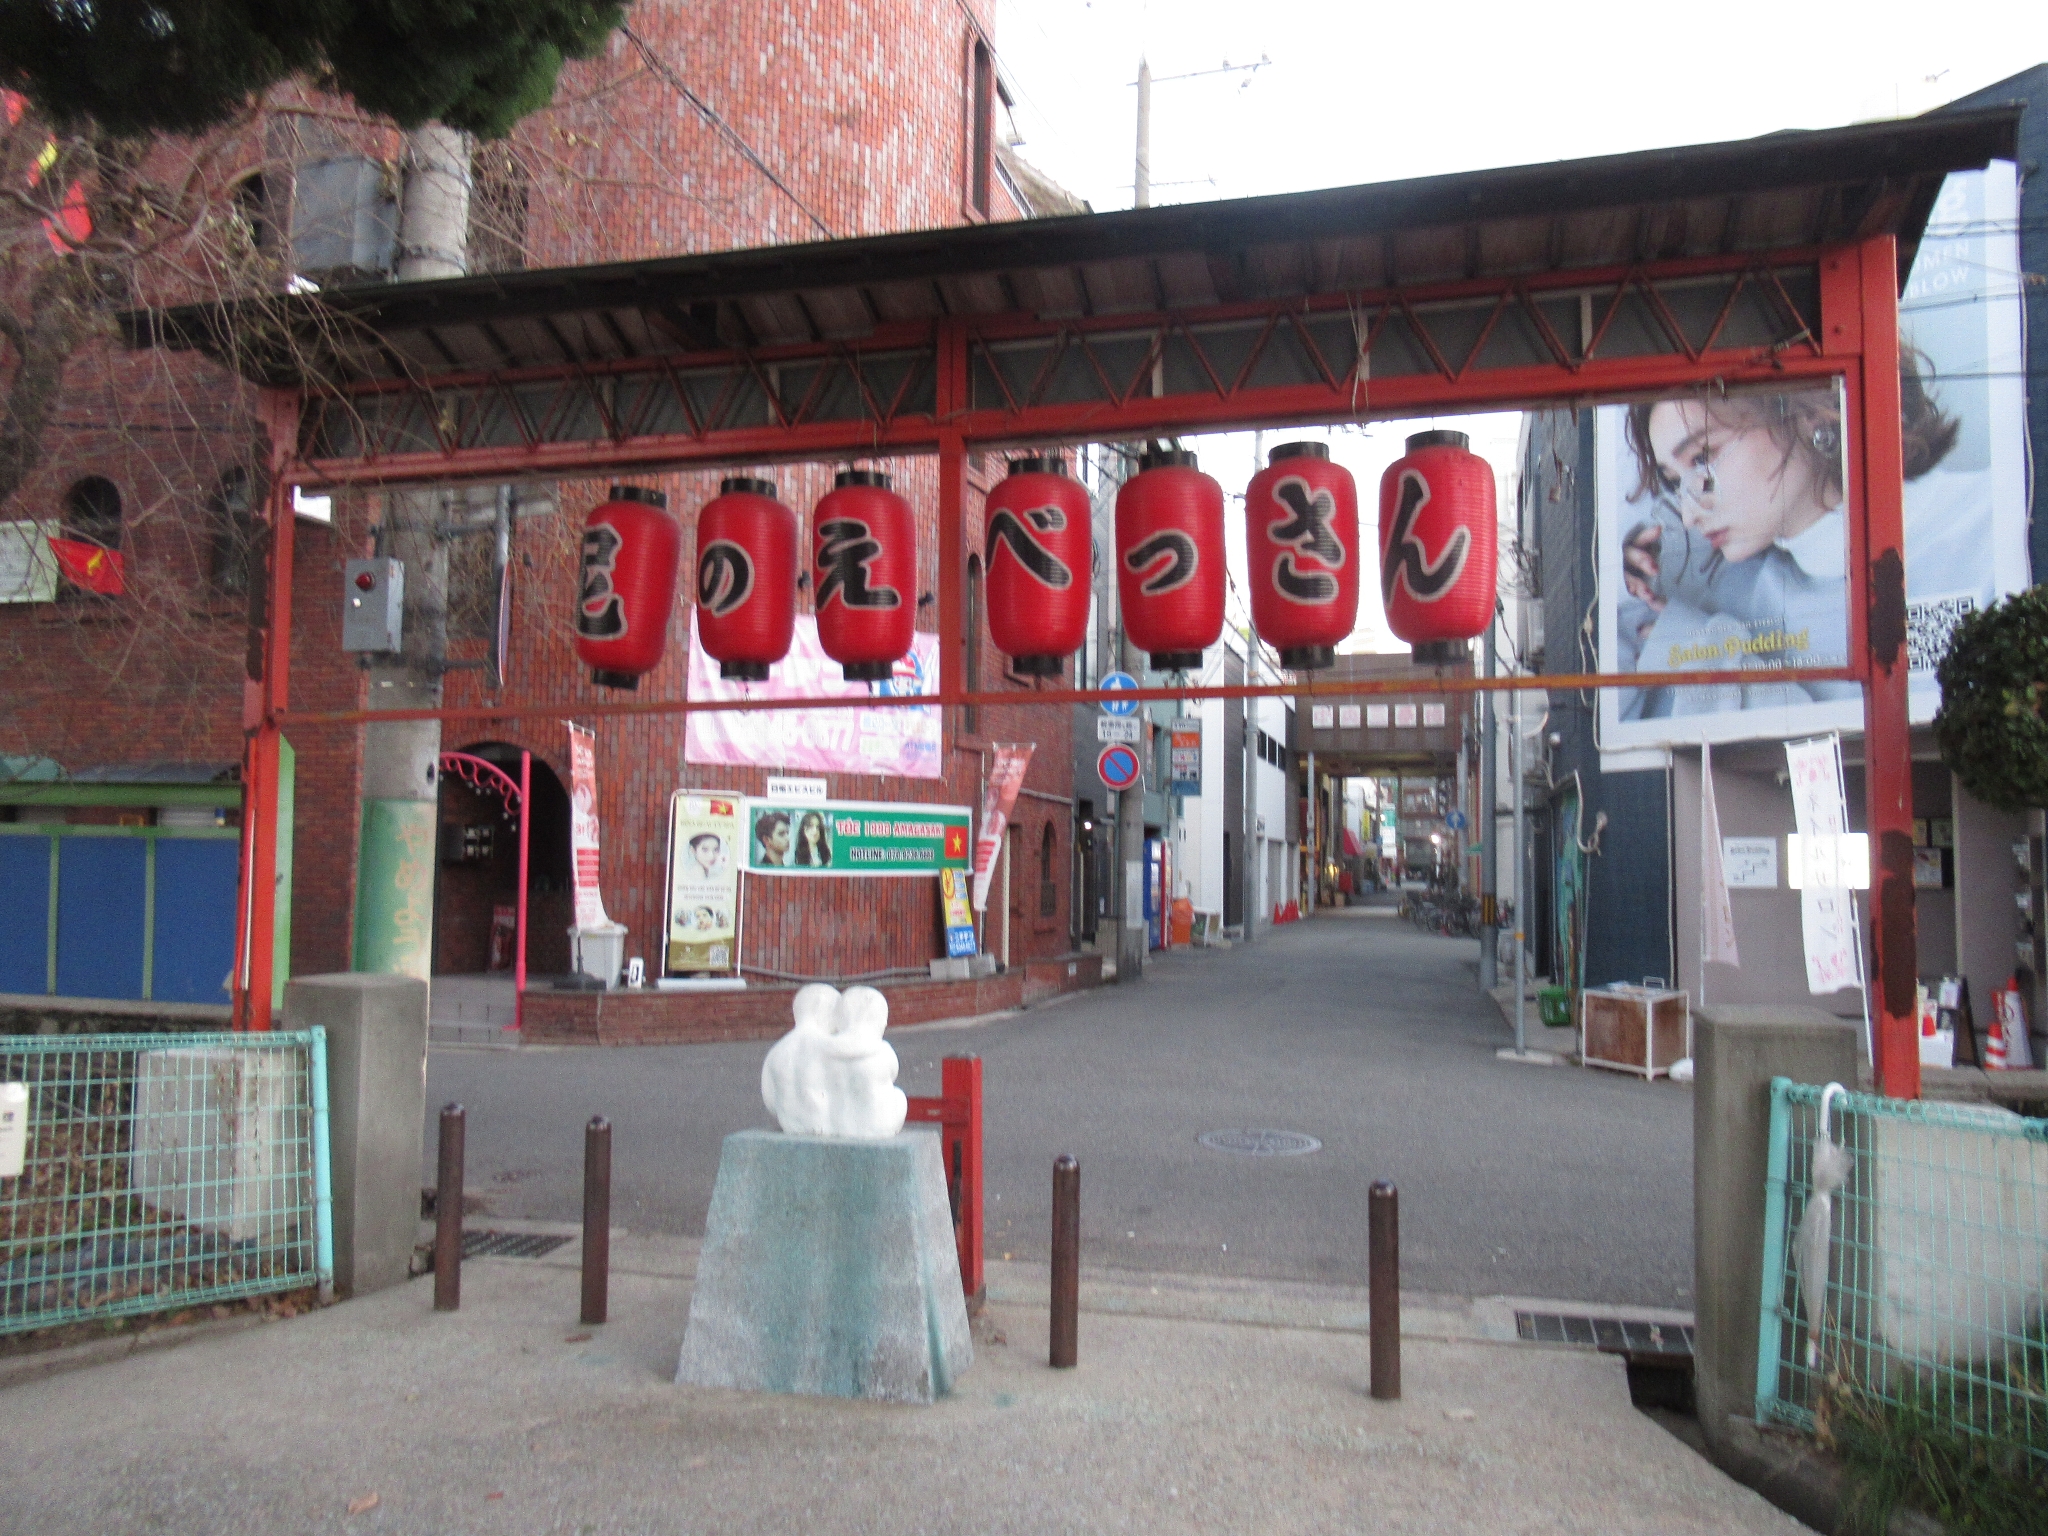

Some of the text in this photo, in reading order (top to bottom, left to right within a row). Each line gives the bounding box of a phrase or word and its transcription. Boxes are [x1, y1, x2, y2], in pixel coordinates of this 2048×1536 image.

[1912, 240, 1969, 275] MEN
[698, 538, 755, 617] の
[814, 517, 903, 612] え
[985, 504, 1073, 591] べ
[1267, 474, 1347, 606] さ
[1381, 467, 1472, 610] ん
[1668, 627, 1809, 669] Salon Pudding
